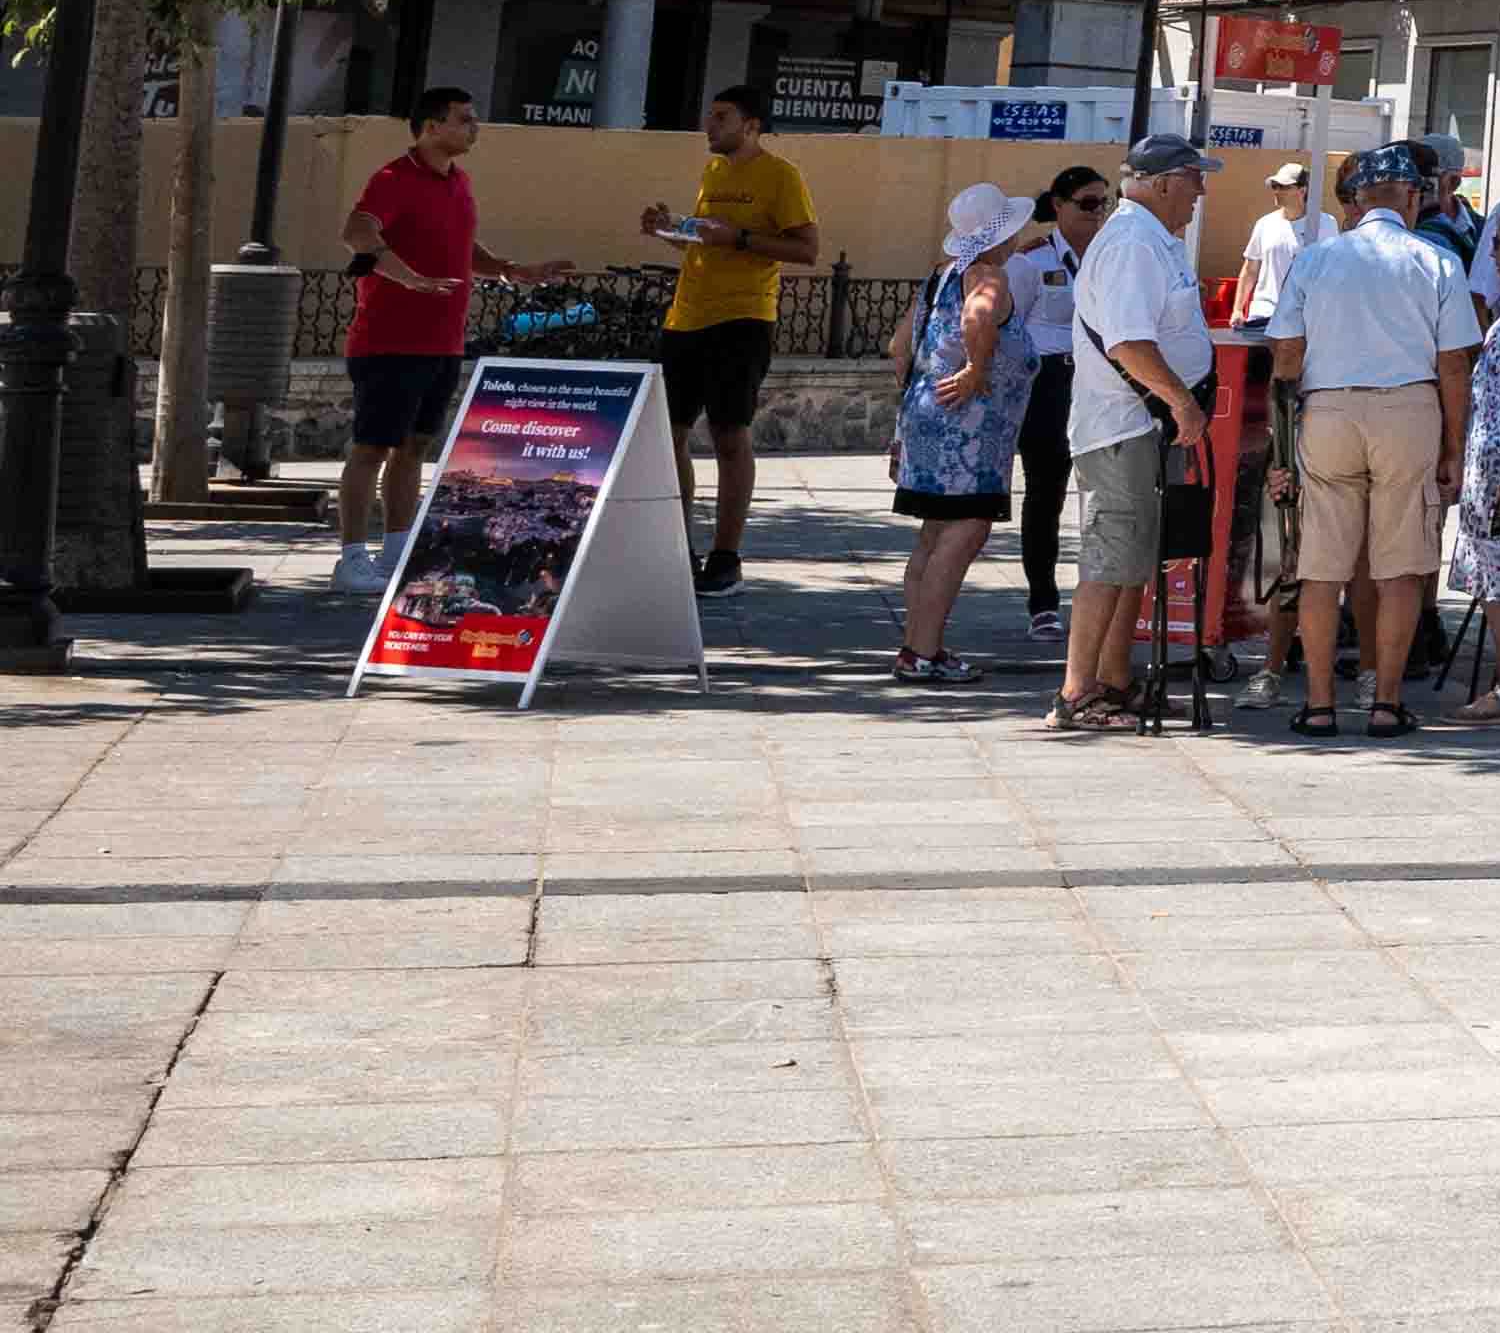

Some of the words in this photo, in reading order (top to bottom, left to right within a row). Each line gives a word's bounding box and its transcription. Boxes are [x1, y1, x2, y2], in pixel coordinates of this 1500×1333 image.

[775, 77, 853, 99] CUENTA
[521, 104, 545, 121] TE
[482, 380, 517, 393] Toledo,
[481, 419, 521, 434] Come
[522, 420, 582, 438] discover
[522, 441, 533, 458] it
[535, 442, 566, 459] with
[567, 445, 592, 460] us!
